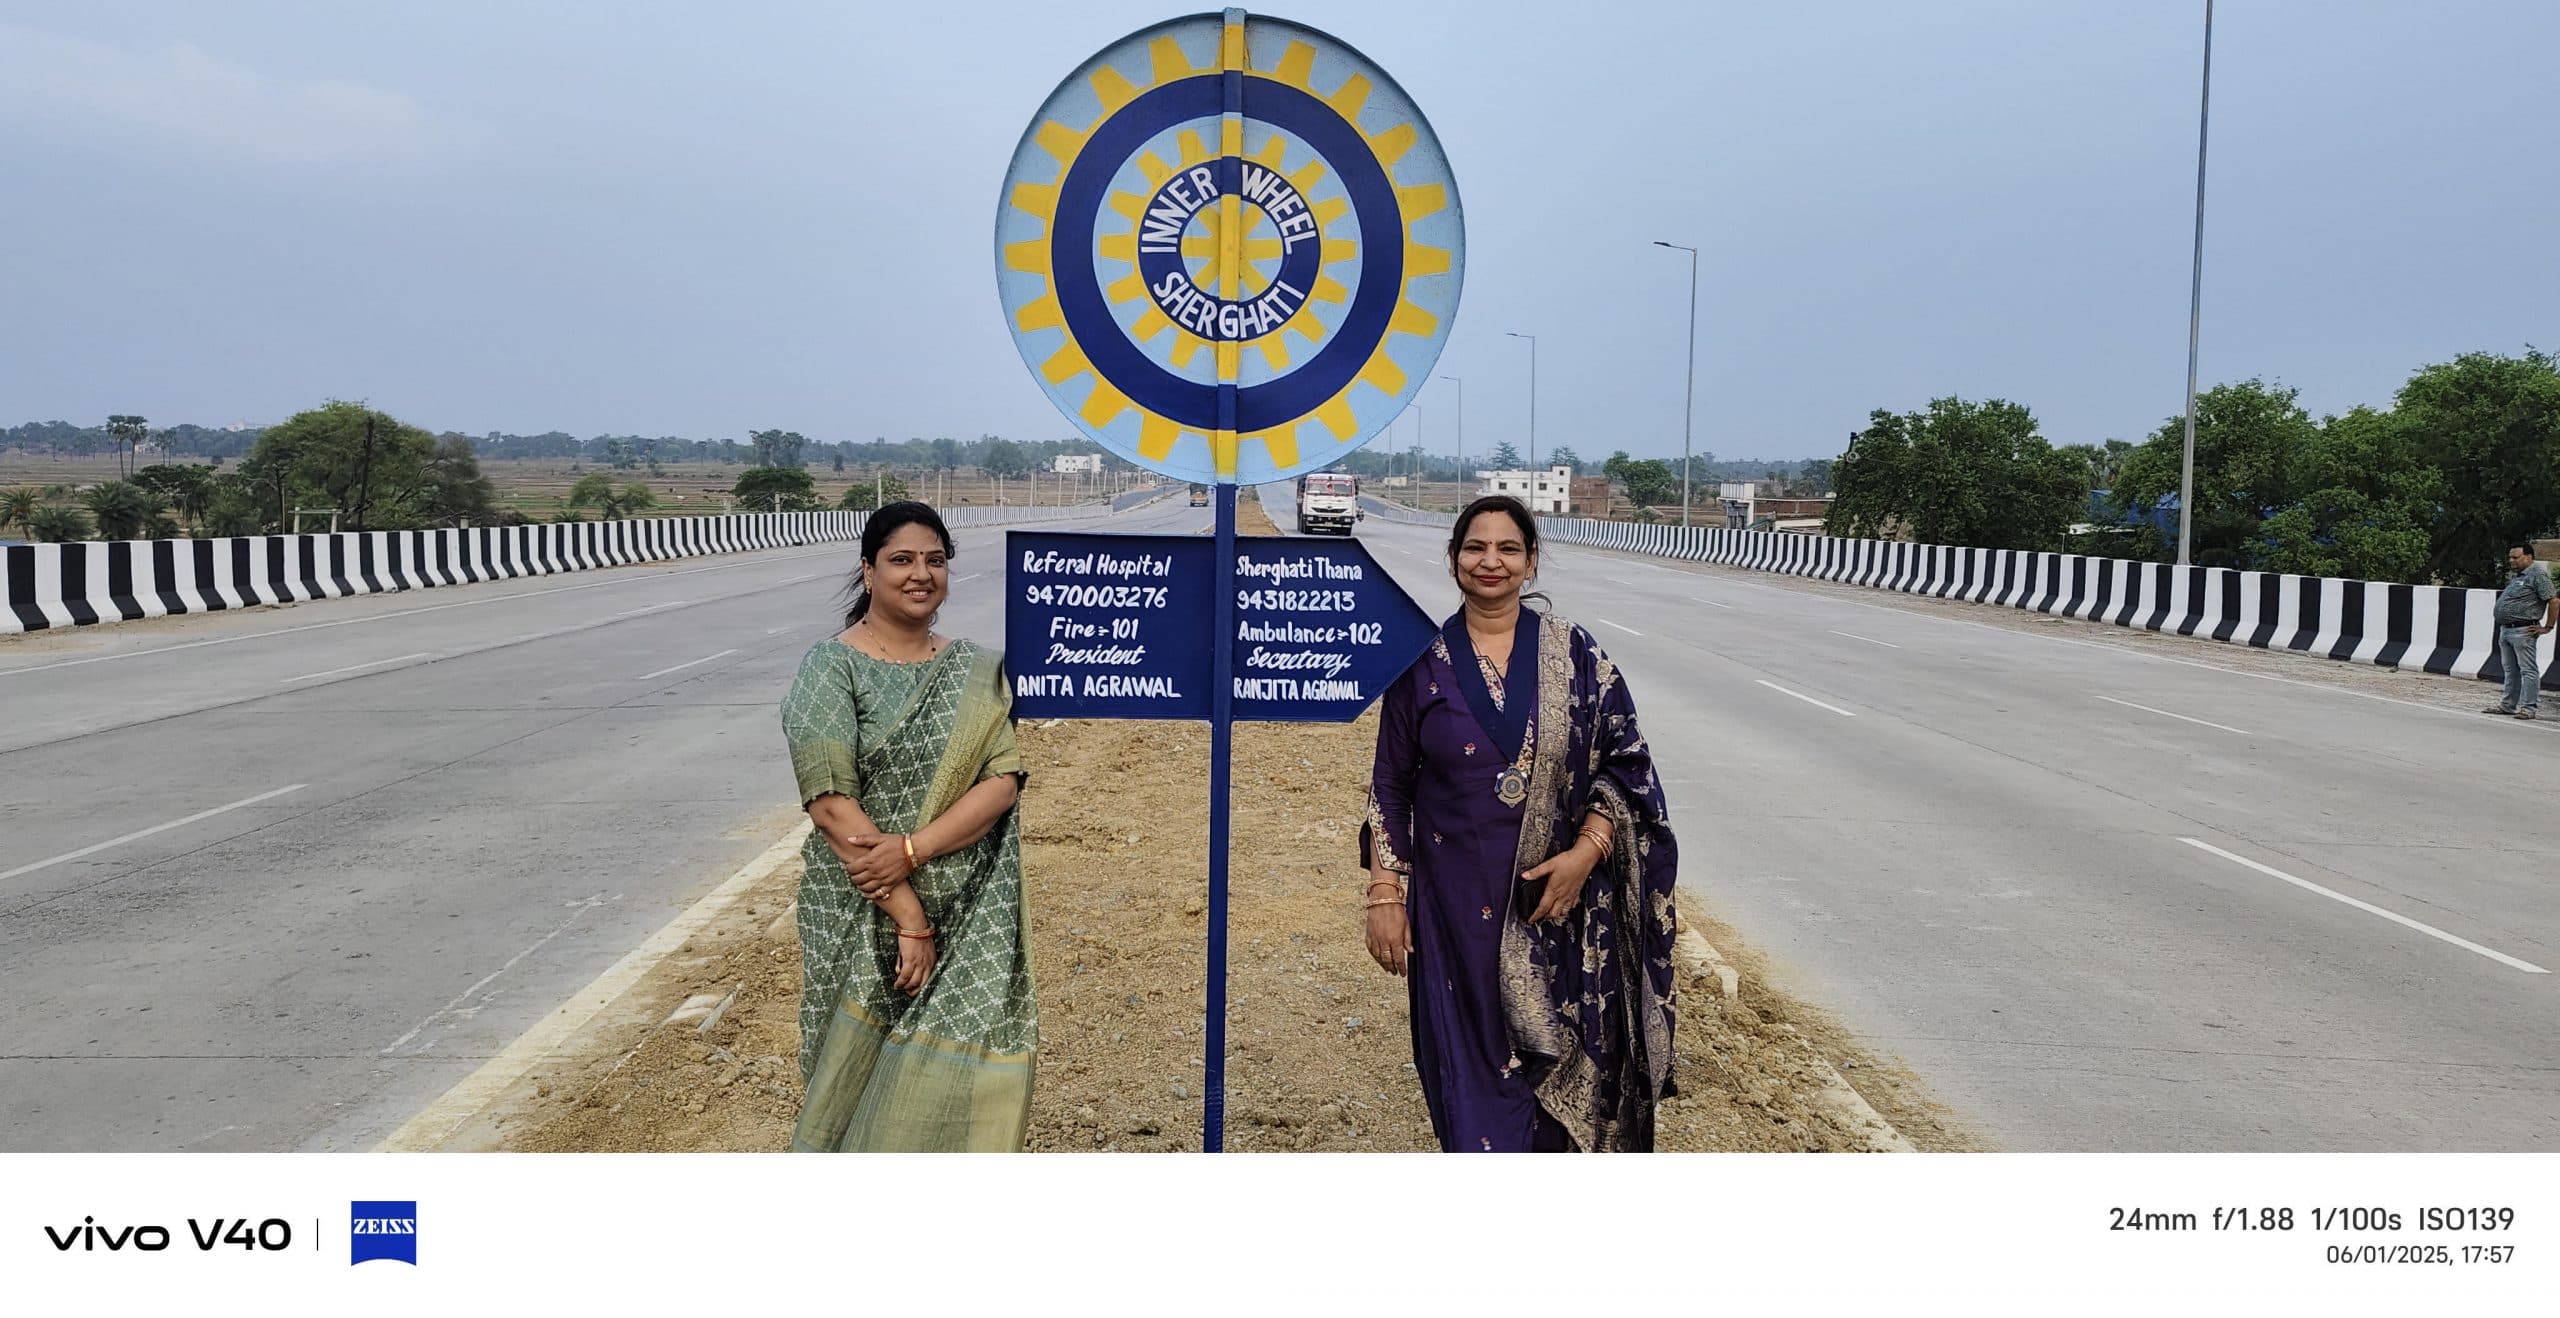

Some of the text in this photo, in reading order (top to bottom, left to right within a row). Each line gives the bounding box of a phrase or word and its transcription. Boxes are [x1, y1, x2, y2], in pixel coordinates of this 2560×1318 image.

[1140, 163, 1317, 256] INNER WHEEL
[1152, 270, 1306, 339] SHERGHATI
[1096, 554, 1173, 581] Hospital
[1236, 555, 1363, 586] Sherghati Thana
[1025, 585, 1169, 609] 9470003276
[1236, 590, 1356, 612] 9431822213
[1045, 643, 1146, 665] President
[1017, 675, 1182, 699] ANITA AGRAWAL
[1233, 677, 1365, 701] RANJITA AGRAWAL
